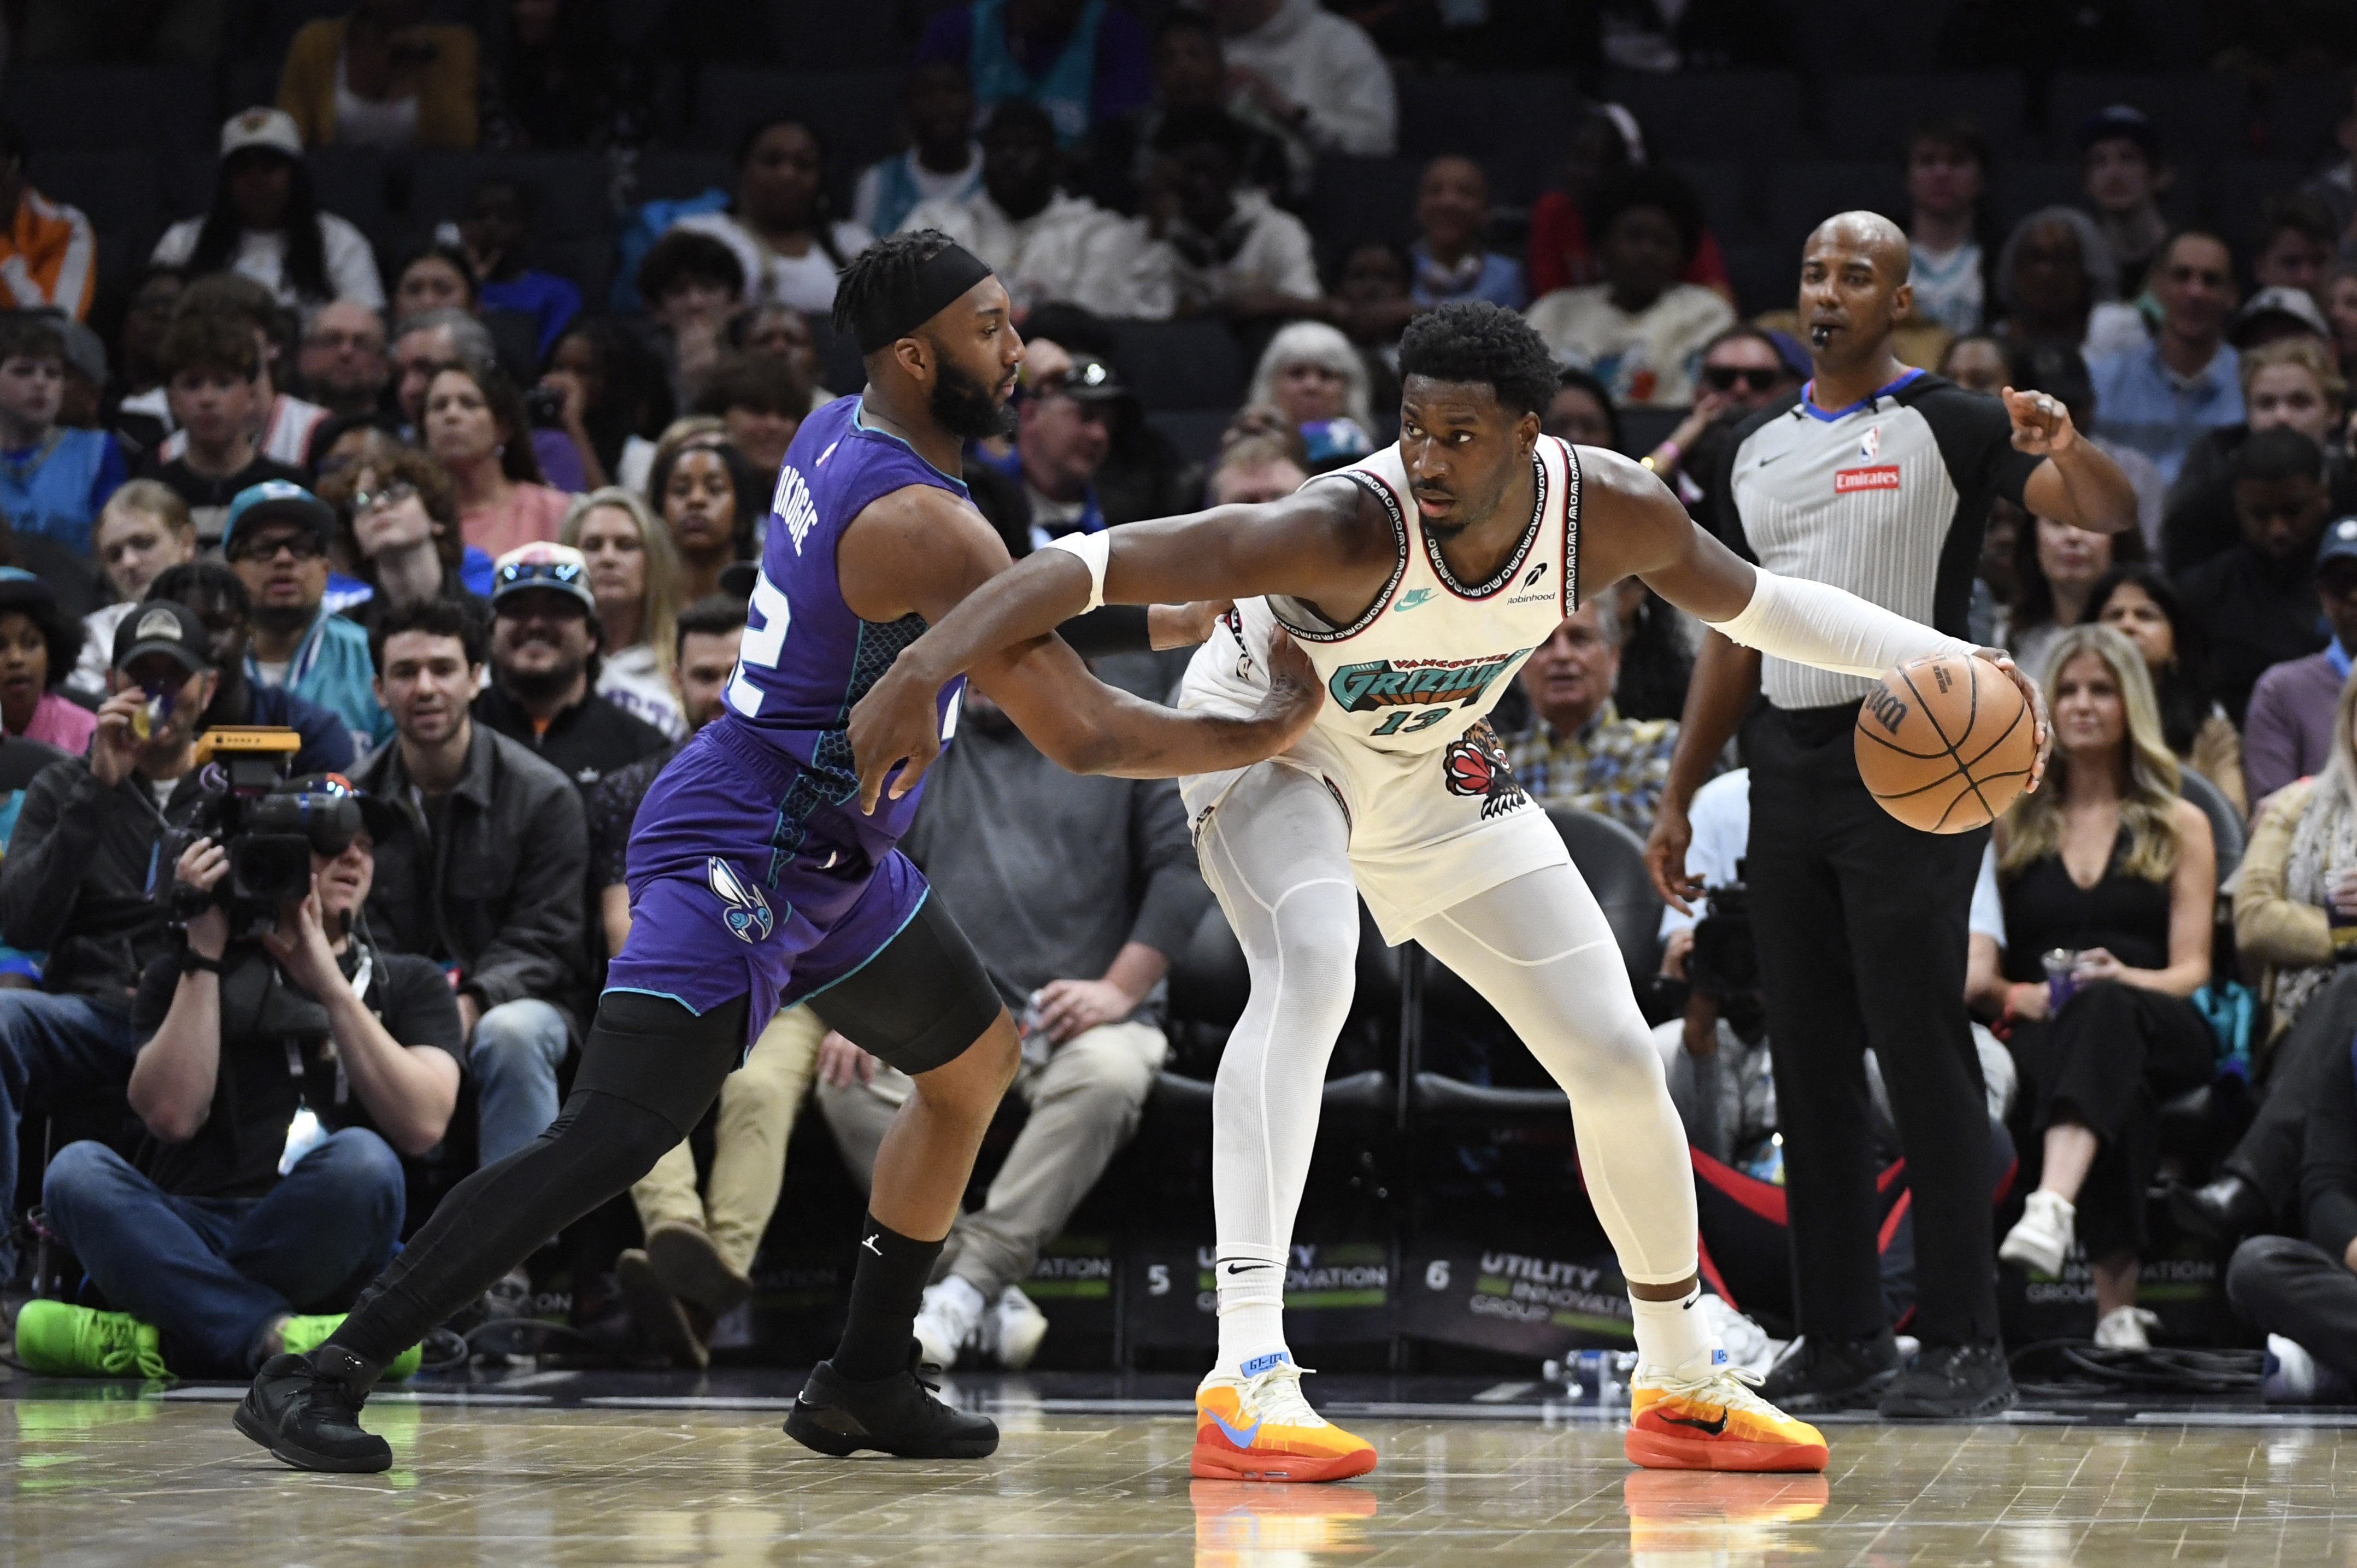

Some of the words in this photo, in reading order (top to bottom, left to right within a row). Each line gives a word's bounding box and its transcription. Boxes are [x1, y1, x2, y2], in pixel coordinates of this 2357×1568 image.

[1836, 471, 1898, 489] Emirates
[773, 465, 818, 557] OKOGIE
[1402, 588, 1432, 603] NIKE
[1507, 591, 1556, 606] Robinhood
[1369, 707, 1453, 737] 13
[1148, 1264, 1171, 1296] 5
[1425, 1259, 1450, 1291] 6
[1480, 1250, 1600, 1290] UTILITY
